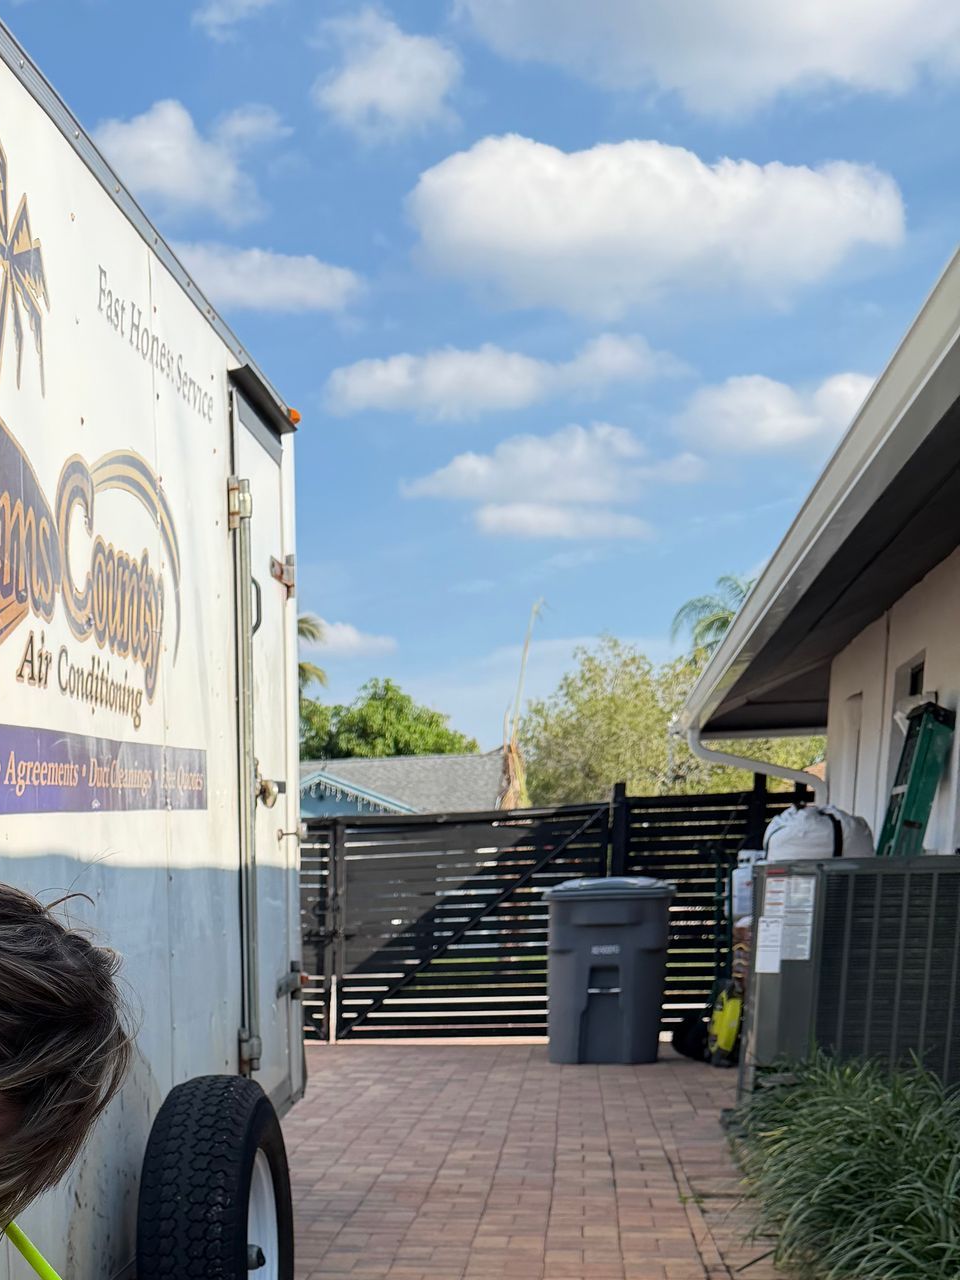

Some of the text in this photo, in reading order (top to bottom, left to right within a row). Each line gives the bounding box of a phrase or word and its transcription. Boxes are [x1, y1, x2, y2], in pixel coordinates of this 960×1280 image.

[97, 264, 214, 424] Fast Honest Service
[55, 452, 166, 705] County
[16, 630, 144, 732] Air Conditioning
[3, 750, 79, 797] Agreements
[110, 759, 153, 797] Cleanings
